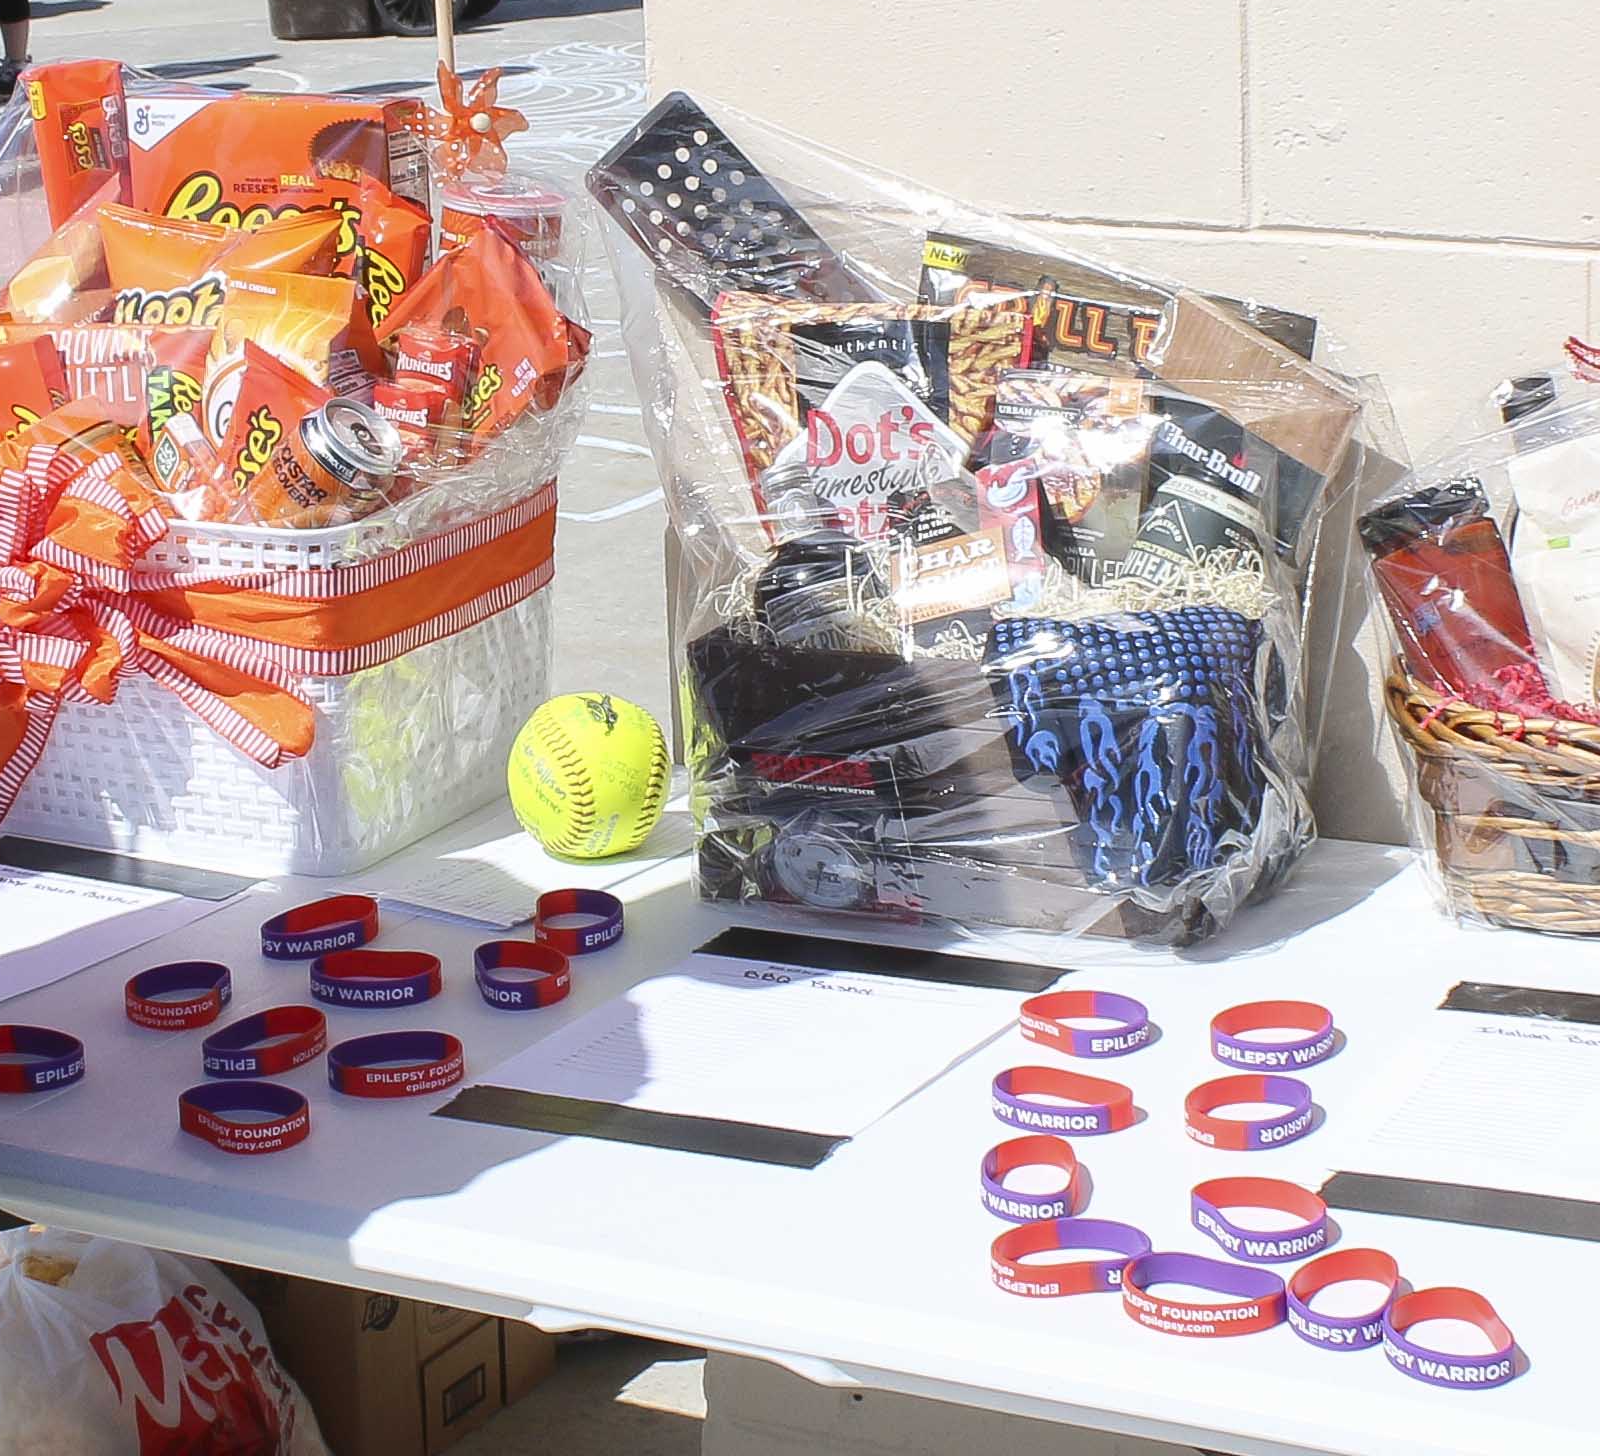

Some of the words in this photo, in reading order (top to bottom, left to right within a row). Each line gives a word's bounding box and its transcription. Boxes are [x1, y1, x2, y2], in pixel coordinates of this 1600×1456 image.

[67, 121, 96, 170] ese's
[233, 183, 278, 194] REESE'S
[279, 175, 315, 187] REAL
[163, 170, 363, 255] Ree's
[47, 328, 154, 364] ROWNIE
[821, 338, 920, 355] authentic
[397, 351, 453, 381] MUNCHIES
[374, 400, 429, 428] MUNCHIES
[806, 405, 936, 468] Dot's
[232, 405, 283, 494] ese's
[1158, 422, 1262, 495] Char-Broil
[271, 452, 315, 509] ECOVERY
[903, 538, 994, 578] HAR
[286, 931, 356, 953] WARRIOR
[743, 969, 792, 985] BBQ
[338, 986, 414, 1002] WARRIOR
[145, 999, 214, 1017] FOUNDATION
[1472, 1025, 1552, 1042] Italian
[1216, 1042, 1289, 1066] EPILEPSY
[366, 1069, 426, 1084] EPILEPSY
[234, 1114, 307, 1140] FOUNDATION
[1015, 1108, 1098, 1130] WARRIOR
[988, 1192, 1065, 1219] WARRIOR
[1243, 1228, 1325, 1257] WARRIOR
[1107, 1269, 1122, 1284] R
[1161, 1304, 1260, 1322] FOUNDATION
[1287, 1306, 1358, 1345] EPILEPSY
[1416, 1358, 1512, 1383] WARRIOR
